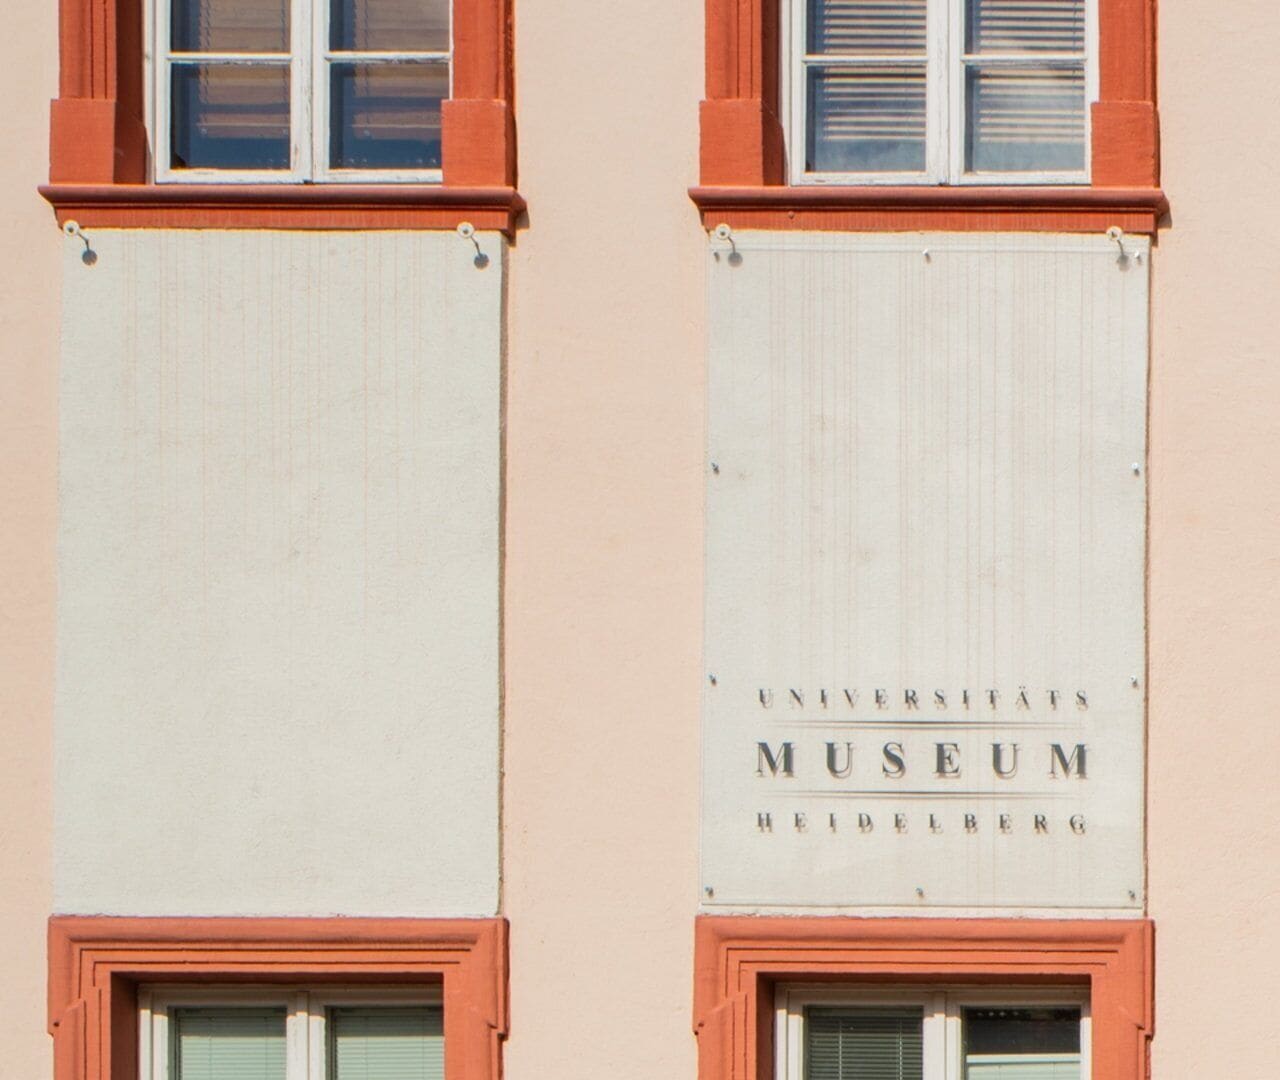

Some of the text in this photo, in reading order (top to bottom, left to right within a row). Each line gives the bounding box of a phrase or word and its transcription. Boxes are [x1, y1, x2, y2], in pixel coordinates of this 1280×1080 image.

[758, 685, 1089, 707] UNIVERSITÄTS
[756, 741, 1089, 776] MUSEUM
[757, 812, 1087, 833] HEIDELBERG
